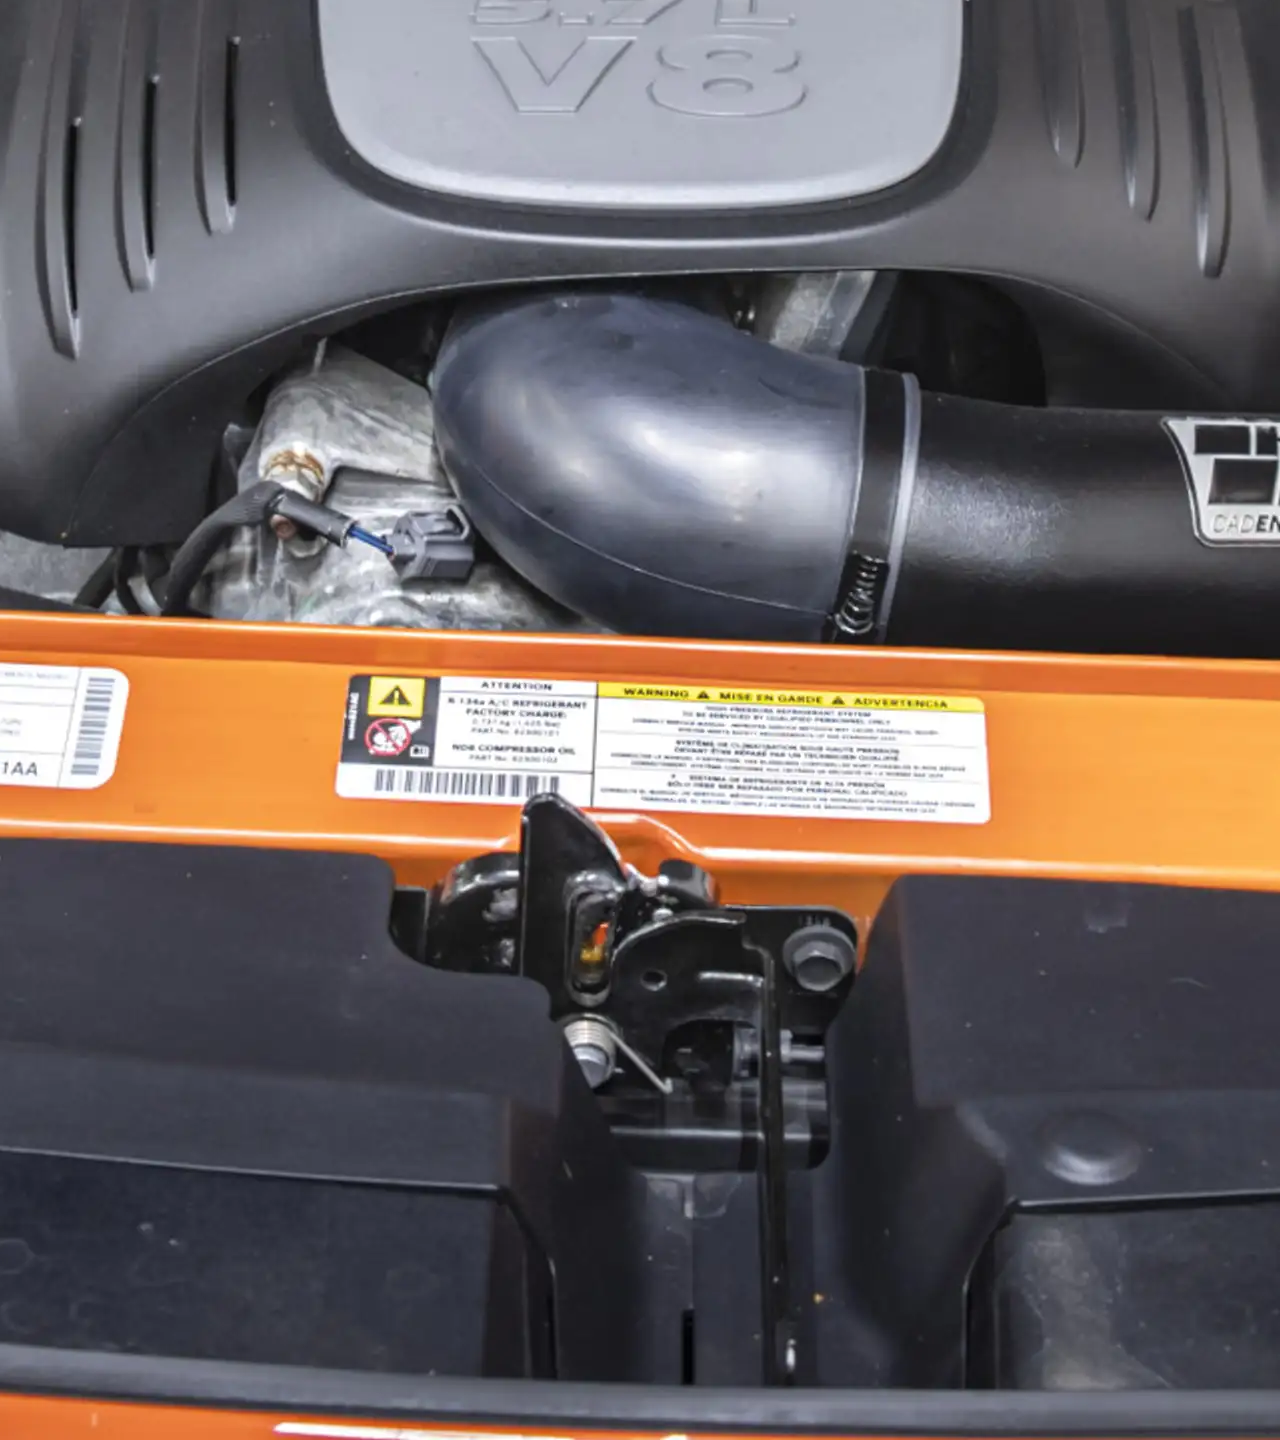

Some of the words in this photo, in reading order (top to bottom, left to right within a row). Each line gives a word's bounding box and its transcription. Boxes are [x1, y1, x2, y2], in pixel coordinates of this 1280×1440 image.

[469, 33, 810, 119] V8
[481, 681, 553, 691] ATTENTION
[623, 688, 690, 699] WARNING
[719, 692, 753, 701] MISE
[756, 693, 774, 702] EN
[777, 695, 823, 705] GARDE
[512, 699, 588, 709] REFRIGERANT
[854, 698, 949, 709] ADVERTENCIA
[465, 708, 516, 717] FACTORY
[478, 744, 555, 754] COMPRESSOR
